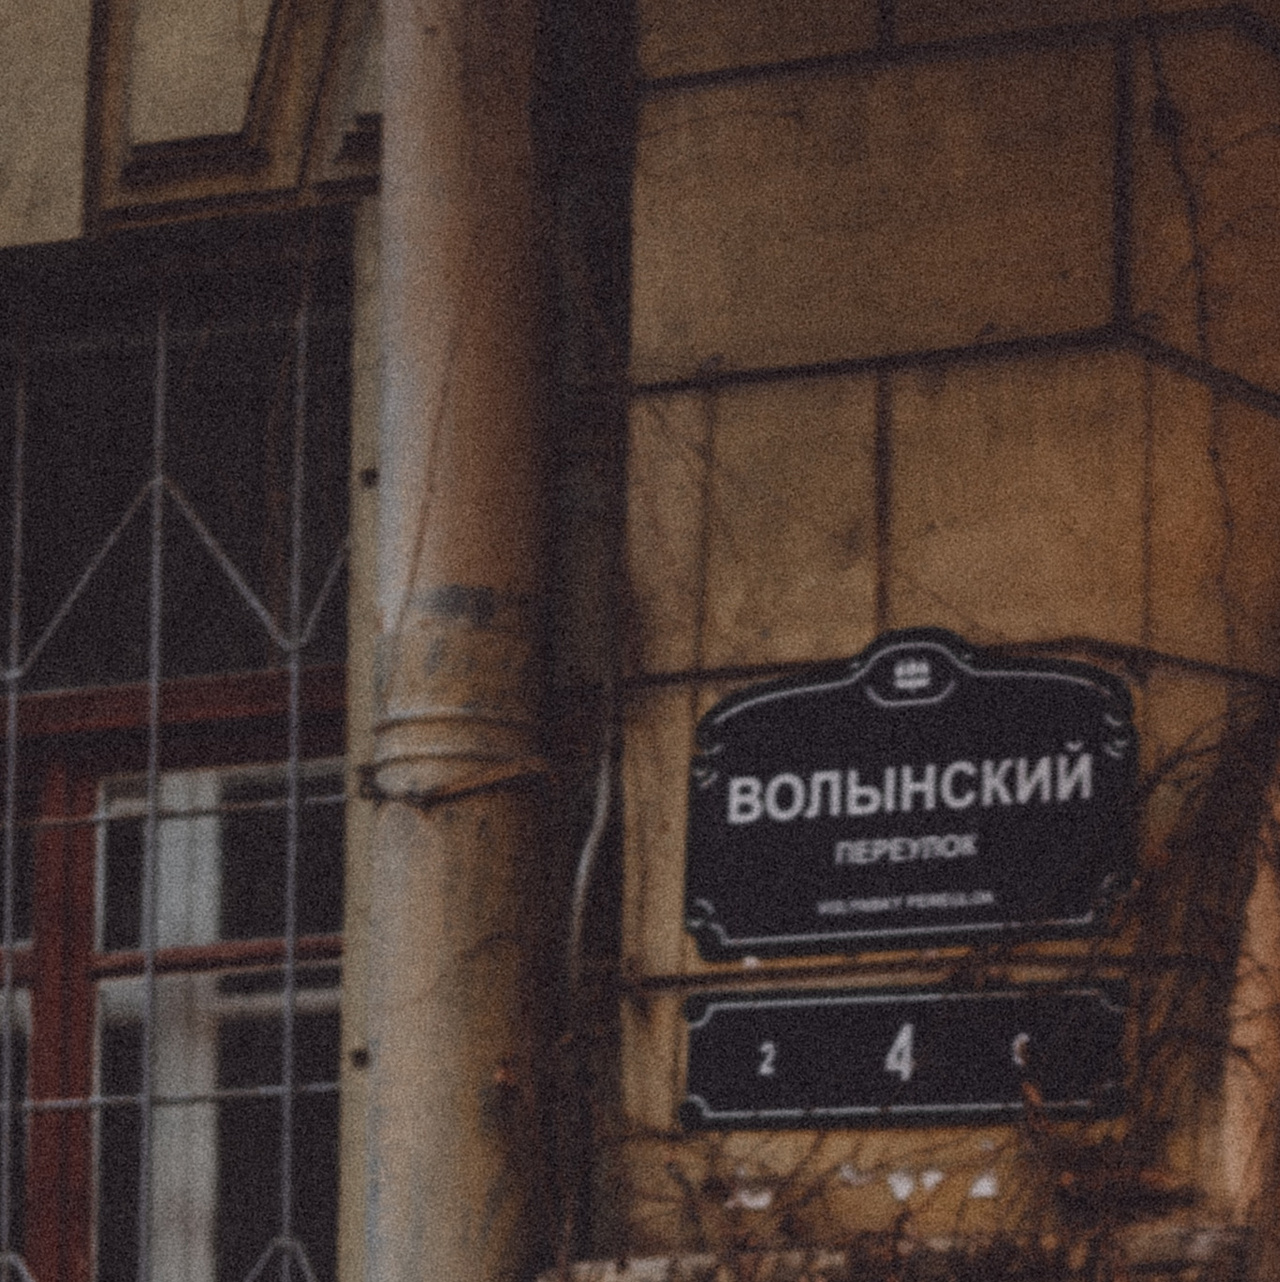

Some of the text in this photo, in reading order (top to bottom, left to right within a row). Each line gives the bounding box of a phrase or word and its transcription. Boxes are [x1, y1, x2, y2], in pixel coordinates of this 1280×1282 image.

[726, 740, 1093, 824] ВОЛЫНСКИЙ
[835, 833, 978, 865] ПЕРЕУЛОК
[758, 1022, 915, 1082] 2 4
